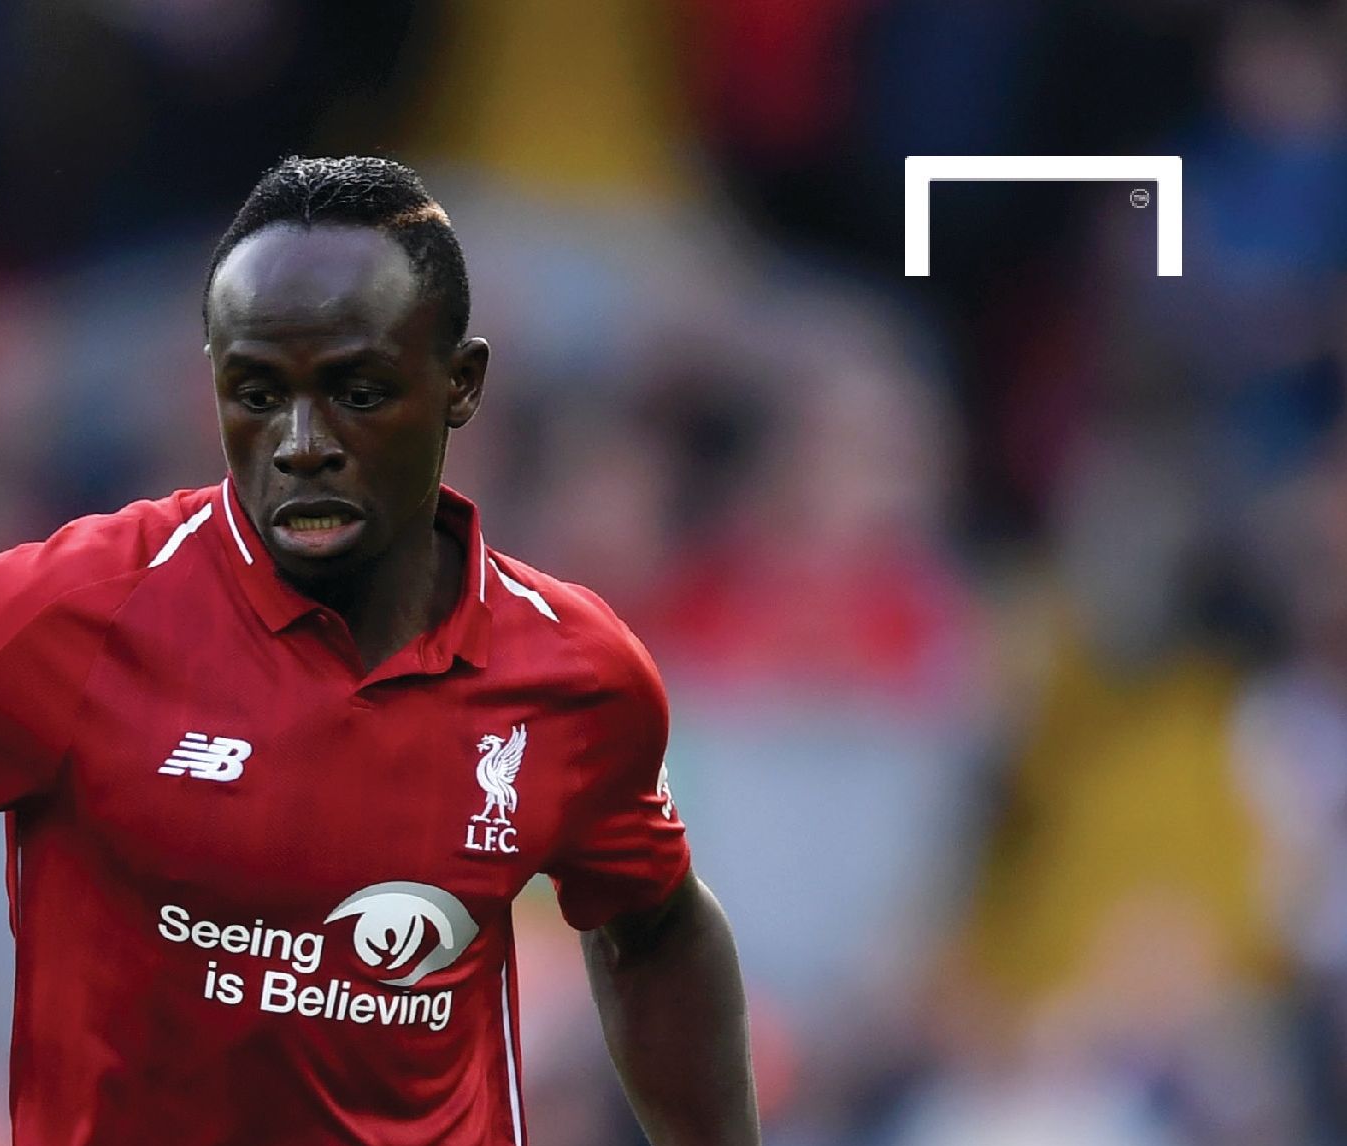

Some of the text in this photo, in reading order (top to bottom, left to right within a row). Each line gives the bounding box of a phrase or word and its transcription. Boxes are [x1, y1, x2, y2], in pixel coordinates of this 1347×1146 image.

[464, 824, 520, 853] L.F.C.
[158, 904, 324, 973] Seeing
[204, 961, 452, 1031] is Believing
